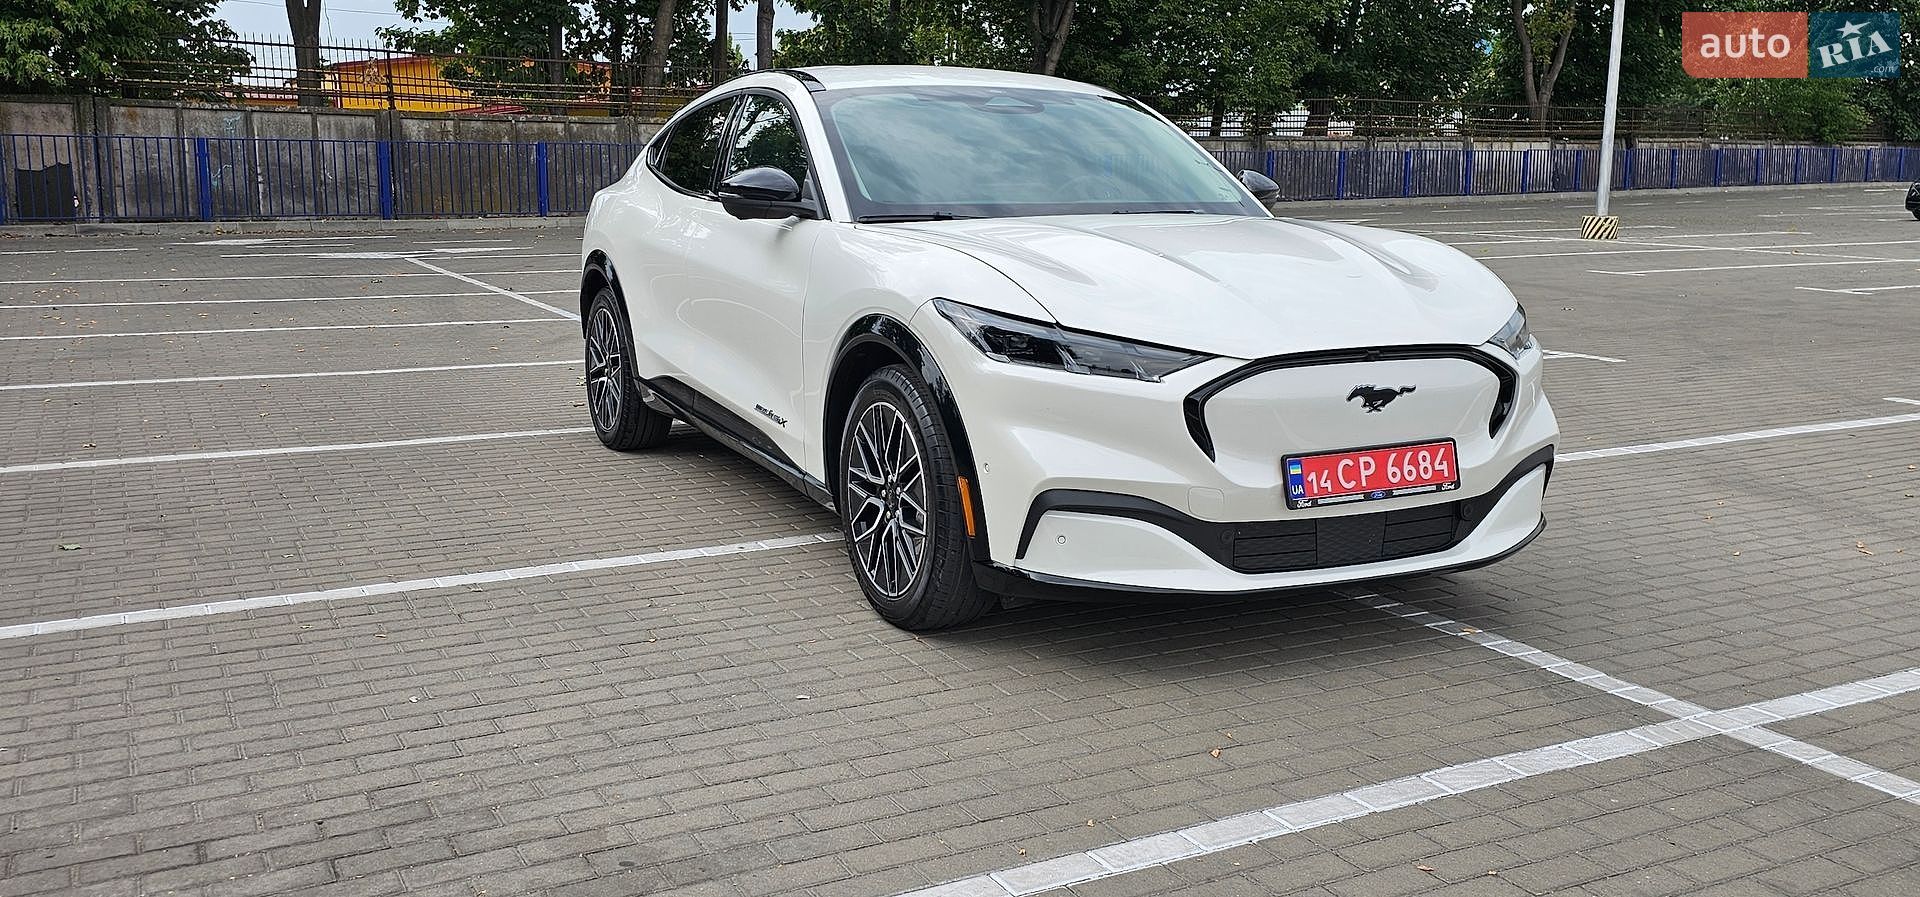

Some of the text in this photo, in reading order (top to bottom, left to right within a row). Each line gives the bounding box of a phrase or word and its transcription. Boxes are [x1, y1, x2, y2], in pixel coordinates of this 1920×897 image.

[1307, 447, 1449, 494] 14 CP 6684
[1291, 484, 1304, 495] UA
[1441, 482, 1455, 491] Ford
[1296, 499, 1312, 509] Ford
